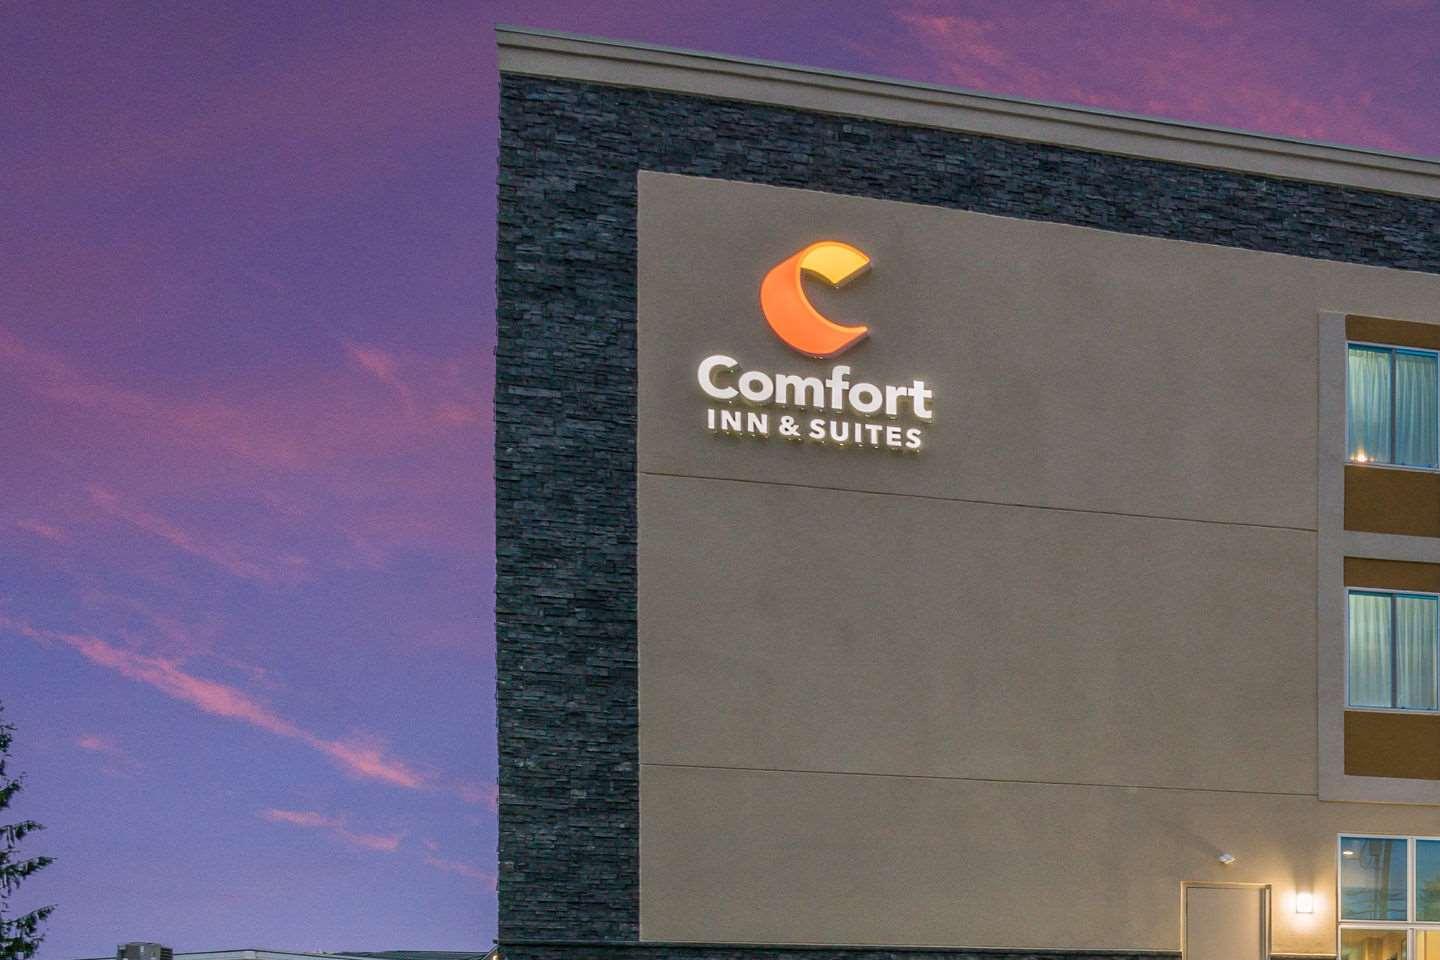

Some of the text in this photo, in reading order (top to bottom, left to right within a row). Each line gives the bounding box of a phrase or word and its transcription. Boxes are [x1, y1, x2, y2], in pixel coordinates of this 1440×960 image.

[697, 354, 933, 419] Comfort
[707, 408, 922, 449] INN & SUITES
